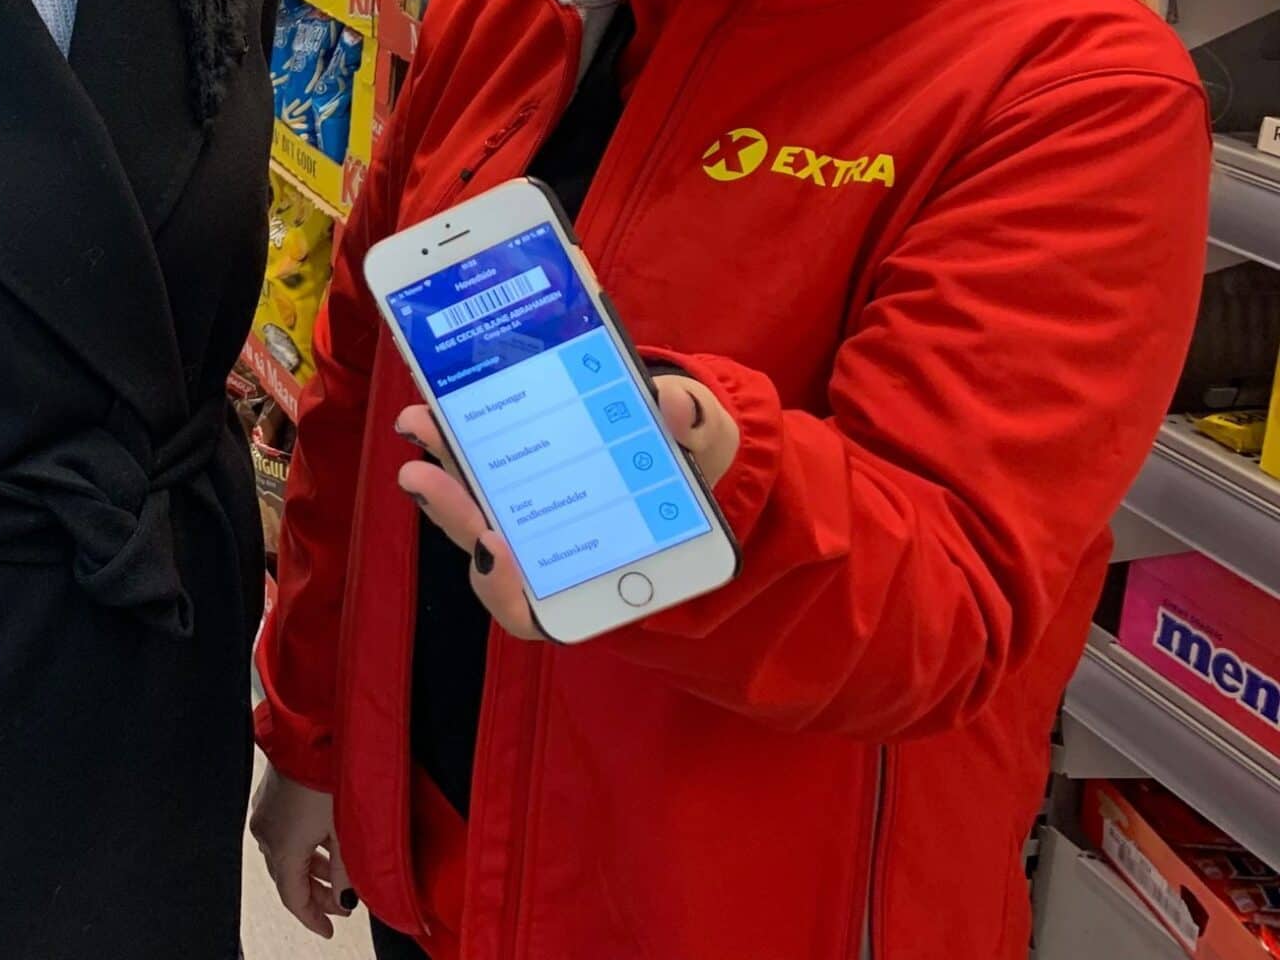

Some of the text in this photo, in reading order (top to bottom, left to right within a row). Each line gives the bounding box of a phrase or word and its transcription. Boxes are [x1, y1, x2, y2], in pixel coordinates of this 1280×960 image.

[771, 146, 895, 188] EXTRA
[464, 390, 527, 423] Mine kuponger
[488, 439, 551, 471] Min kundeavis
[510, 498, 533, 514] Faste
[516, 489, 588, 526] medlemsfordeler
[537, 538, 600, 568] Medlemskupp
